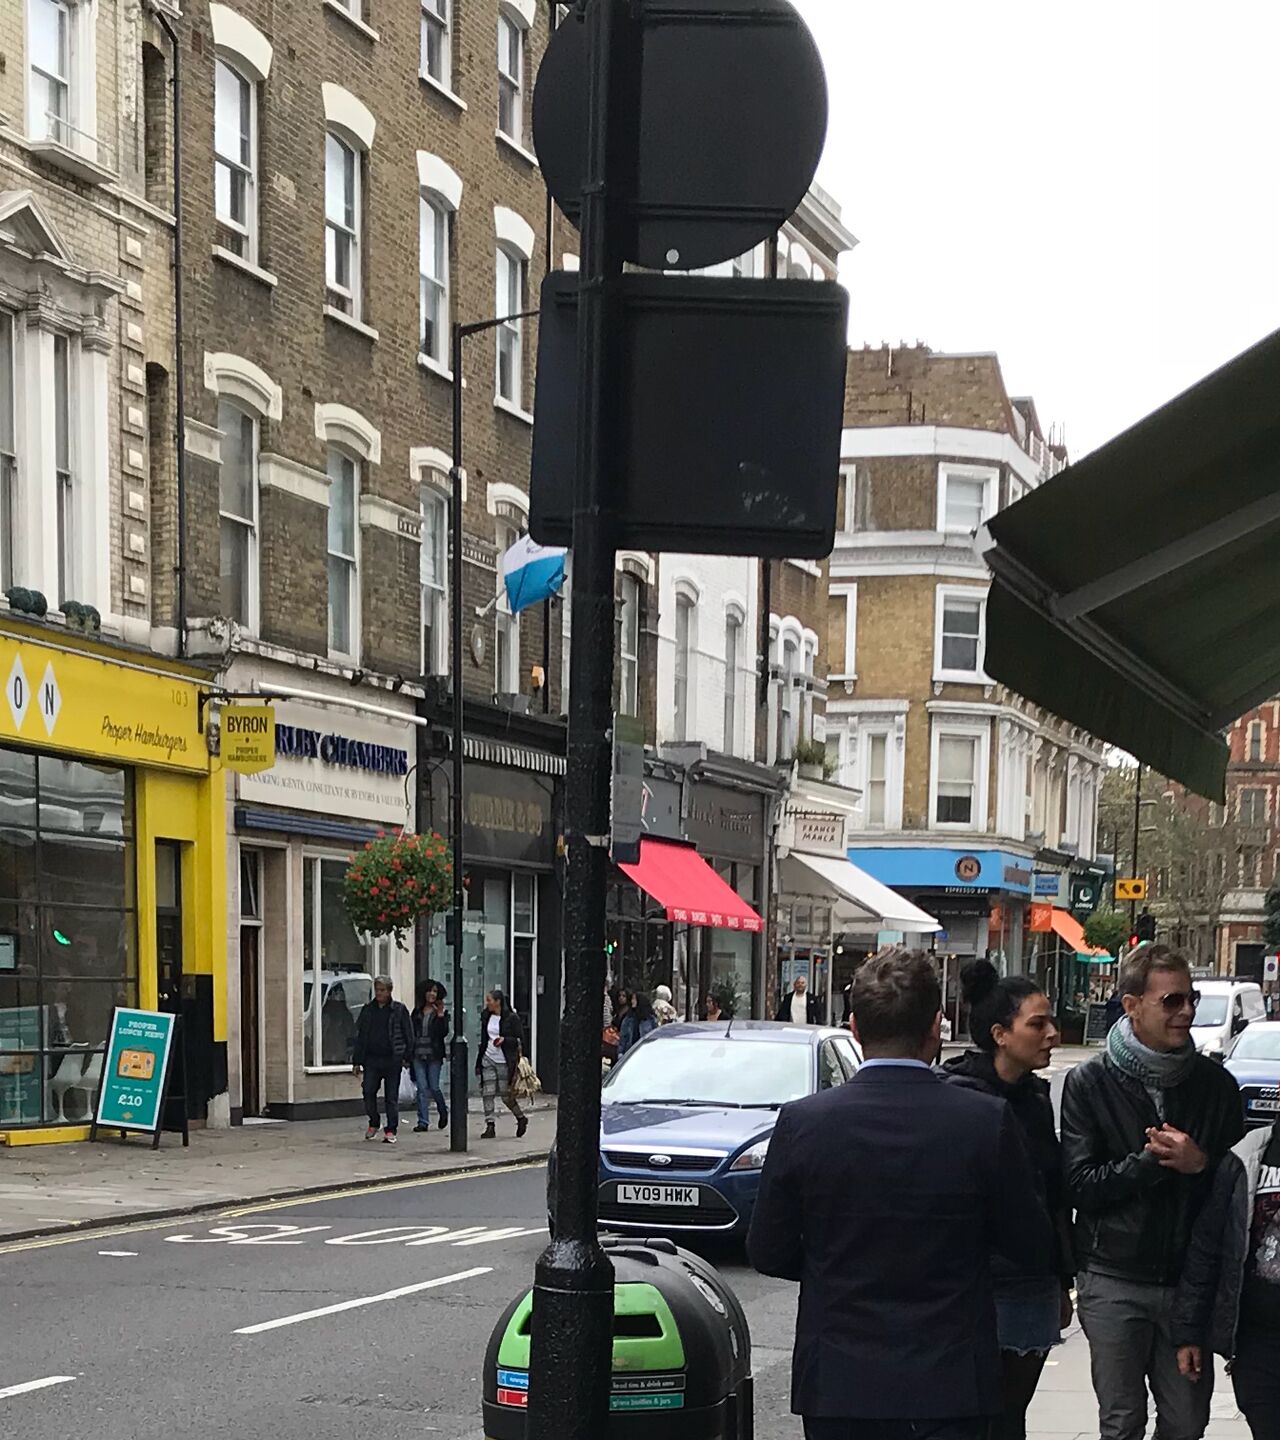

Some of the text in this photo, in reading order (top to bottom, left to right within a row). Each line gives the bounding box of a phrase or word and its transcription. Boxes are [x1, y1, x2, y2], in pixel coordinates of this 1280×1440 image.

[171, 690, 189, 707] 103
[227, 716, 268, 733] BYRON
[101, 715, 187, 759] Proper Hamburgers
[321, 732, 408, 776] CHAMBERS
[803, 824, 836, 833] FRANCO
[802, 833, 835, 842] MANCA
[128, 1021, 157, 1030] PROPER
[118, 1094, 142, 1106] £10
[623, 1187, 693, 1202] LY09 HWK
[164, 1224, 549, 1247] SLOW
